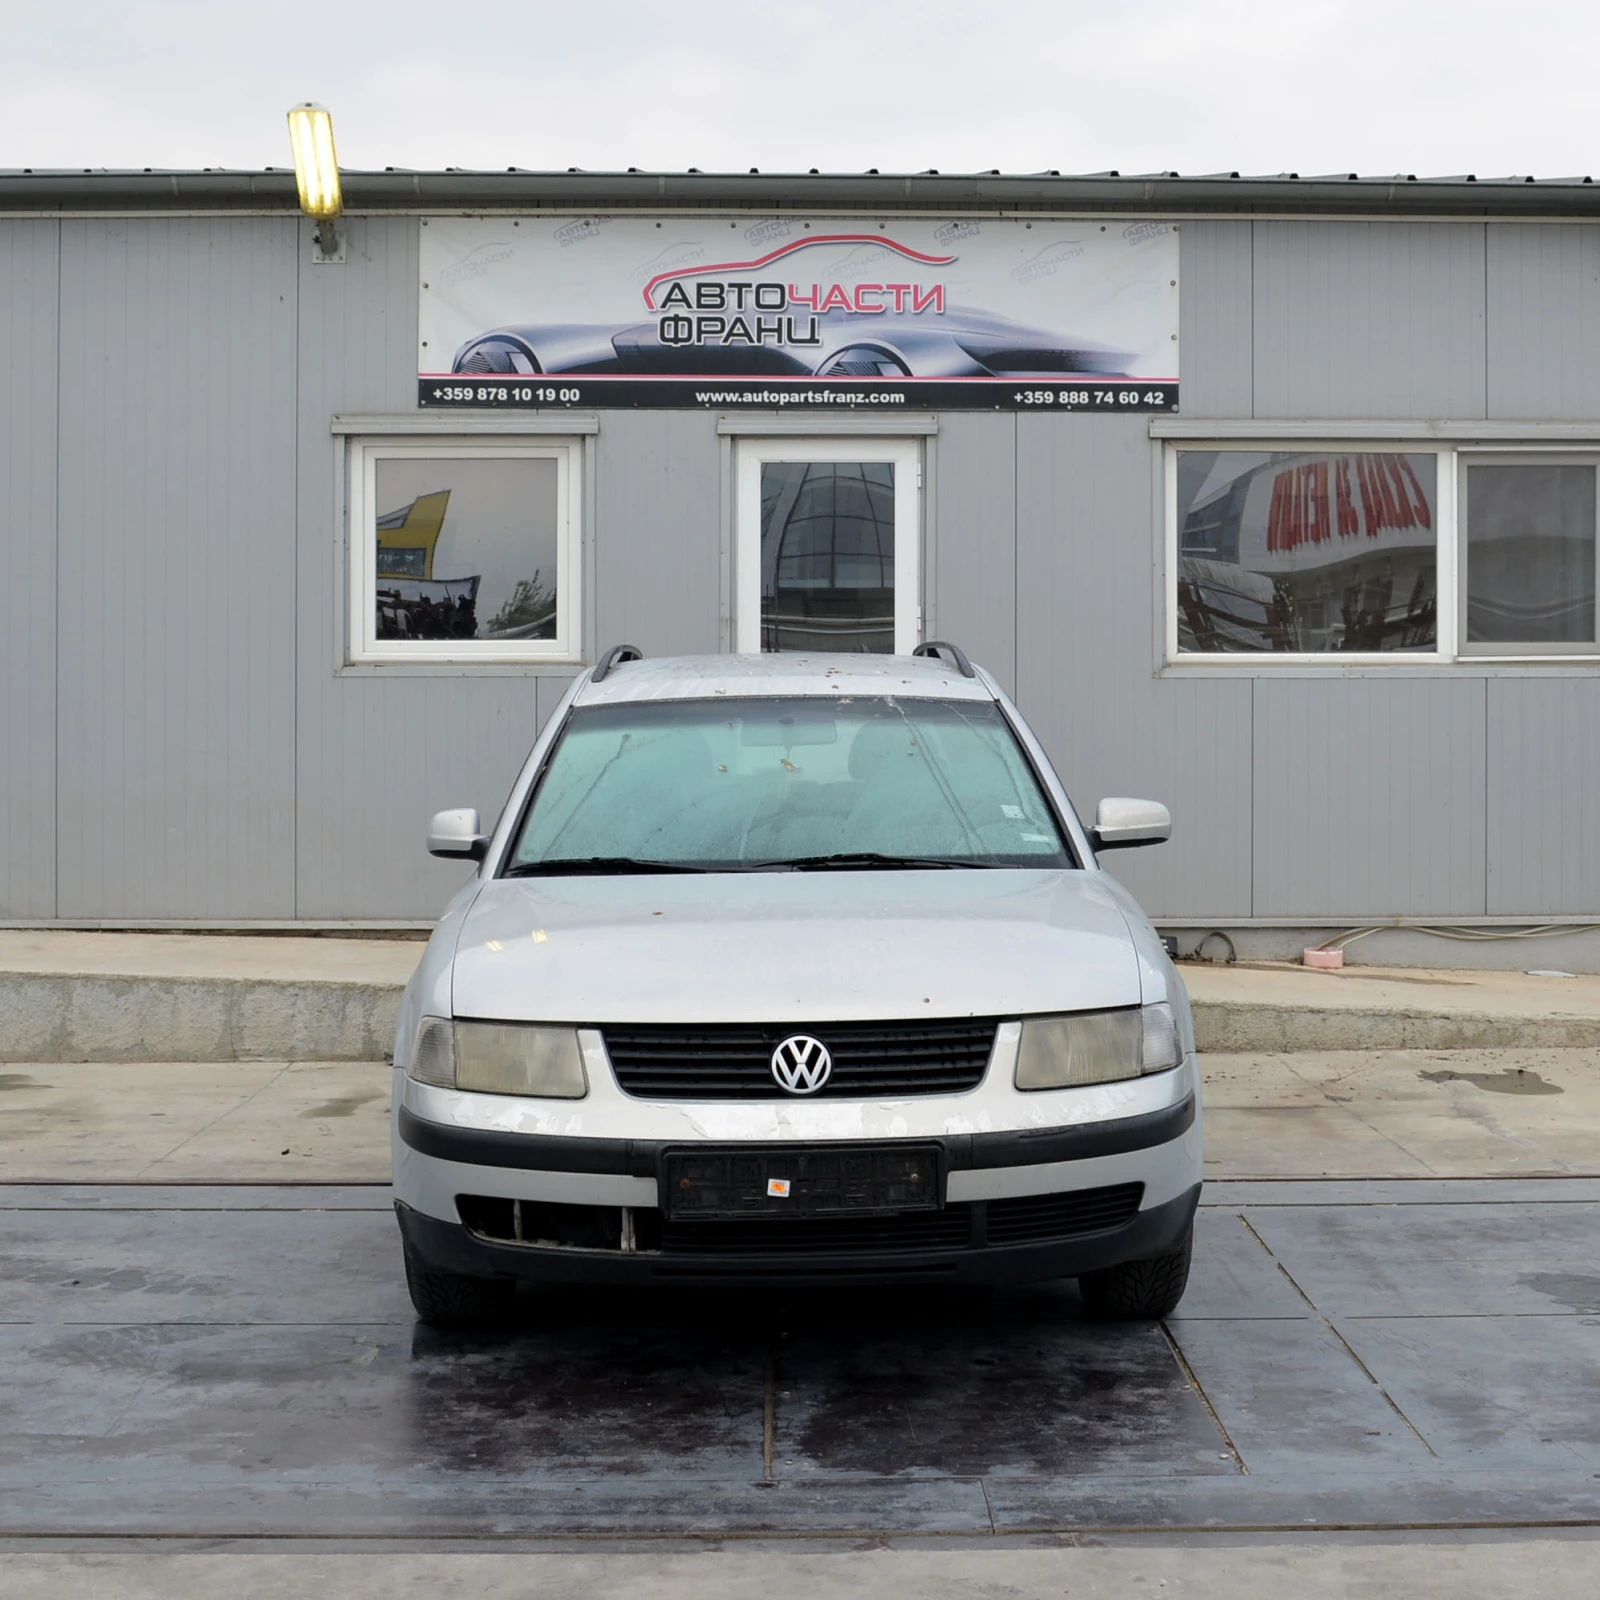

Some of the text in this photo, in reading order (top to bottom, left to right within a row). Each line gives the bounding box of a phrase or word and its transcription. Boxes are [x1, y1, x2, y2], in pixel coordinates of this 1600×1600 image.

[659, 281, 944, 313] АВТОЧАСТИ
[659, 313, 820, 346] ФРАНЦ
[432, 387, 580, 402] +359 878 10 19 00
[695, 390, 905, 408] www.autopartsfranz.com
[1013, 390, 1166, 405] +359 888 74 60 42
[772, 1036, 832, 1094] VW
